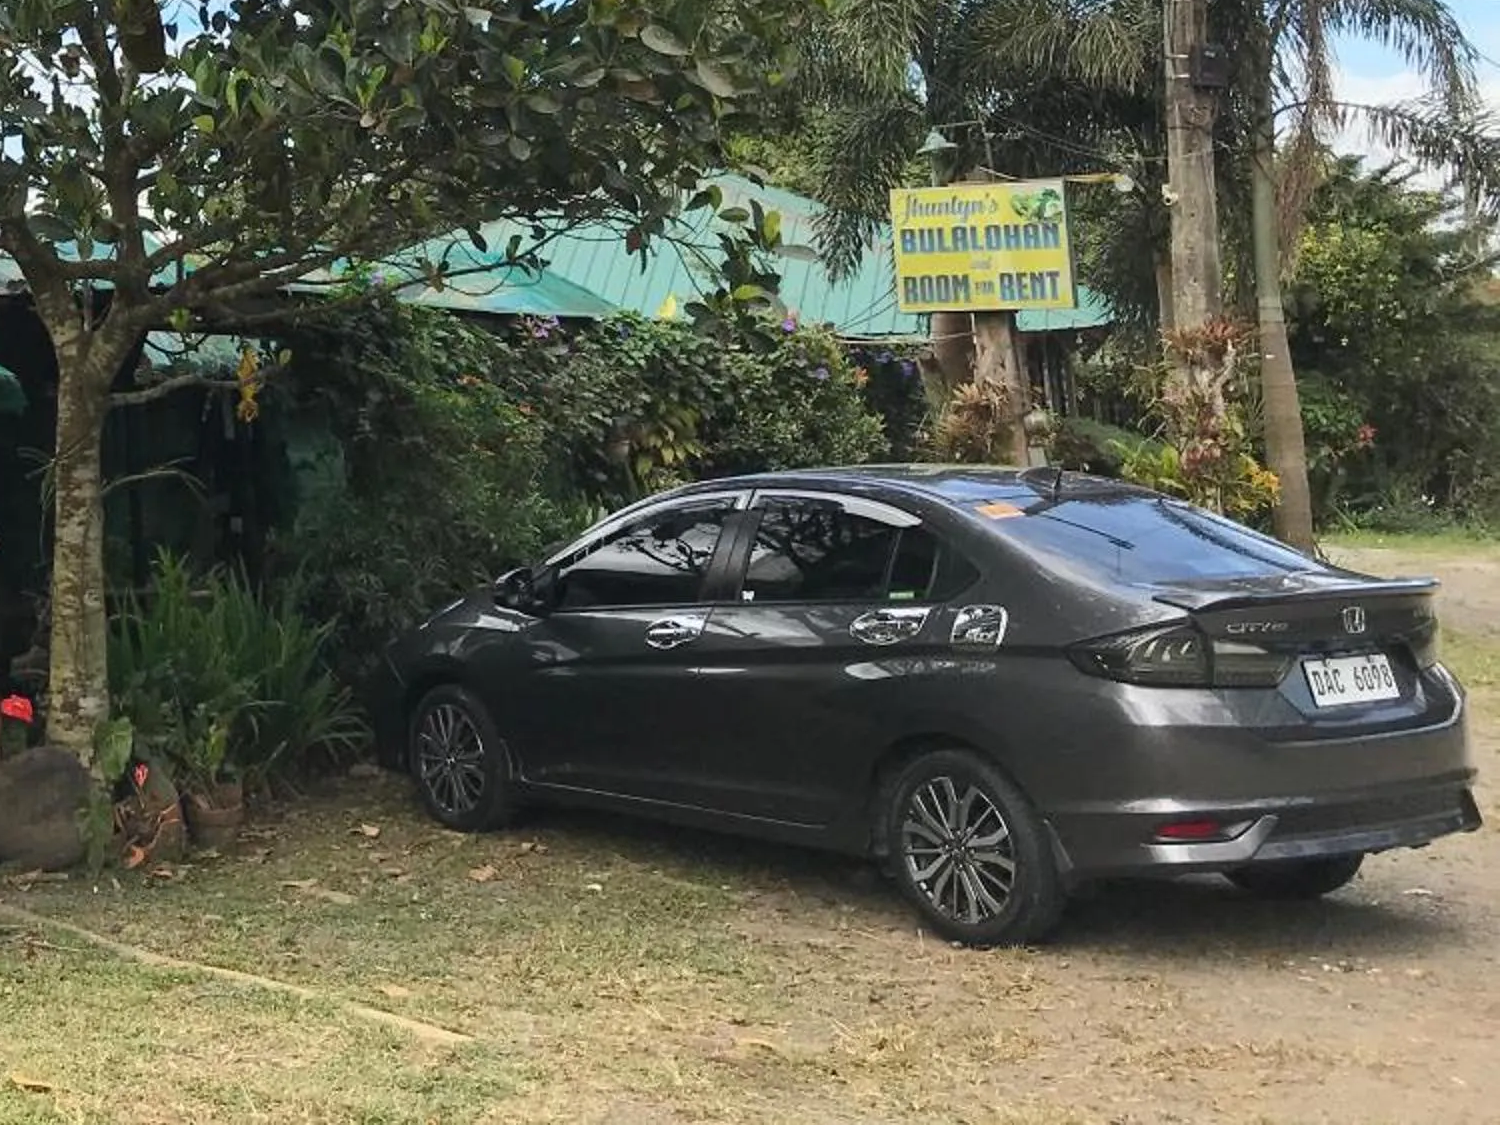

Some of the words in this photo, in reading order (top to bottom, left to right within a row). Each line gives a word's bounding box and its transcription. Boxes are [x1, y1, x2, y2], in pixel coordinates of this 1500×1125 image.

[901, 223, 1060, 253] BULALOHAN
[903, 274, 972, 304] ROOM
[999, 271, 1061, 301] RENT
[1311, 668, 1345, 696] DAC
[1353, 664, 1393, 692] 6098
